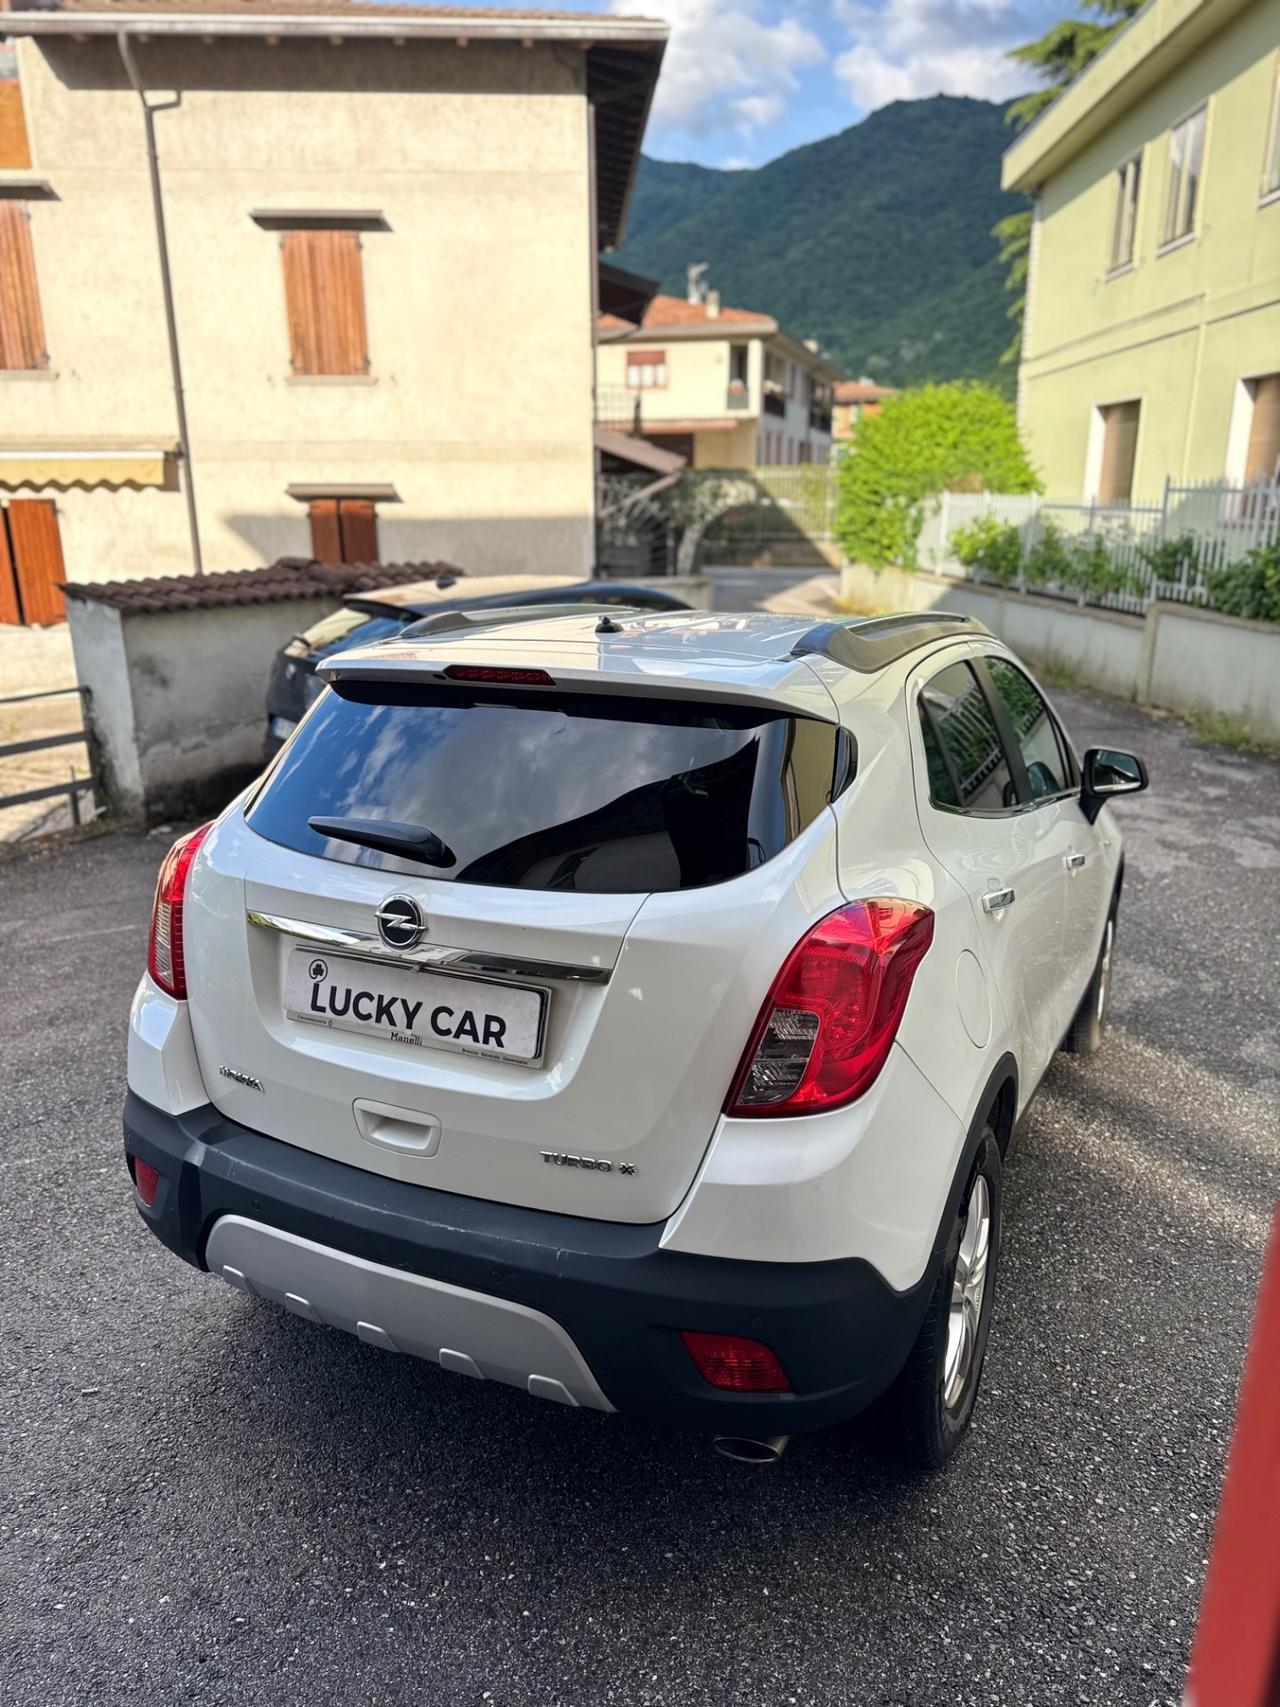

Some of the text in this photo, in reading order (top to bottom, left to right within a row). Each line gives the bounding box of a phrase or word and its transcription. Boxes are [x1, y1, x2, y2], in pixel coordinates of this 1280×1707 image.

[310, 983, 507, 1048] LUCKY CAR
[390, 1032, 423, 1046] Manelli
[540, 1150, 612, 1172] TURBO
